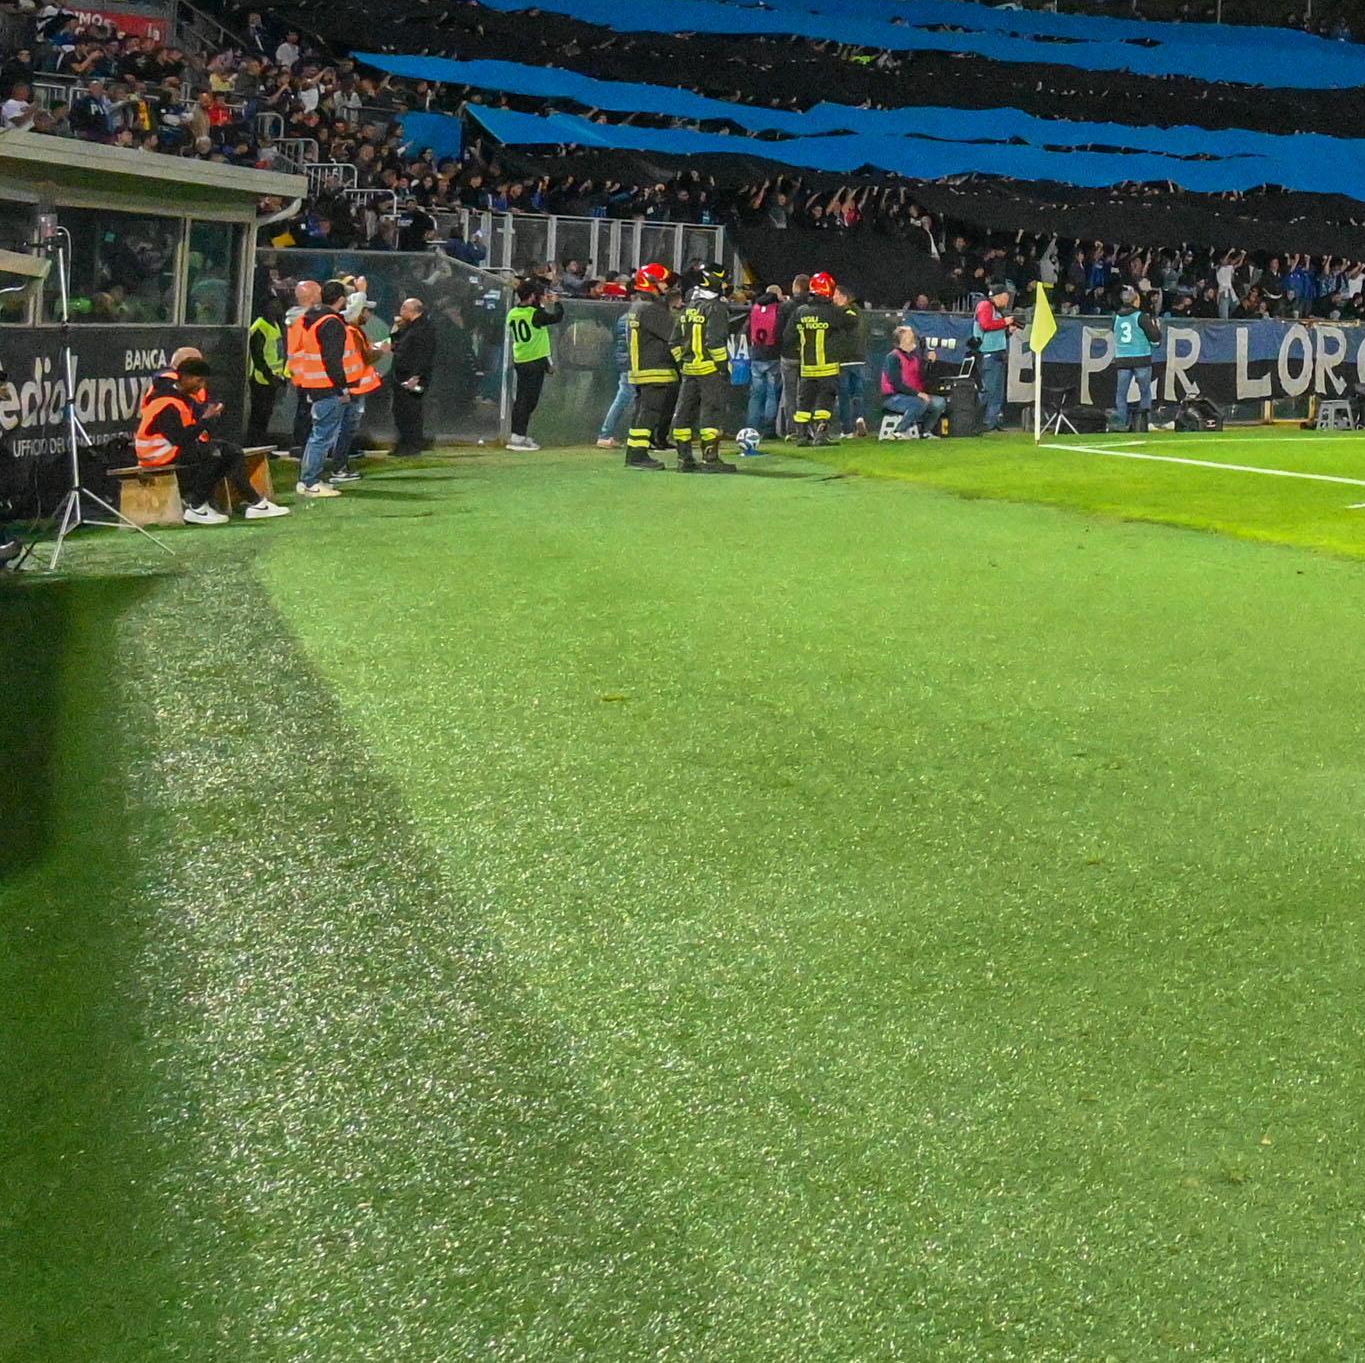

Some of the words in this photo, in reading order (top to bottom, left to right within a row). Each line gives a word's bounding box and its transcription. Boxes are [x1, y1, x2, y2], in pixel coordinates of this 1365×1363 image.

[509, 319, 532, 343] 10
[1120, 320, 1132, 343] 3
[125, 349, 167, 371] BANCA
[1080, 326, 1201, 405] PR
